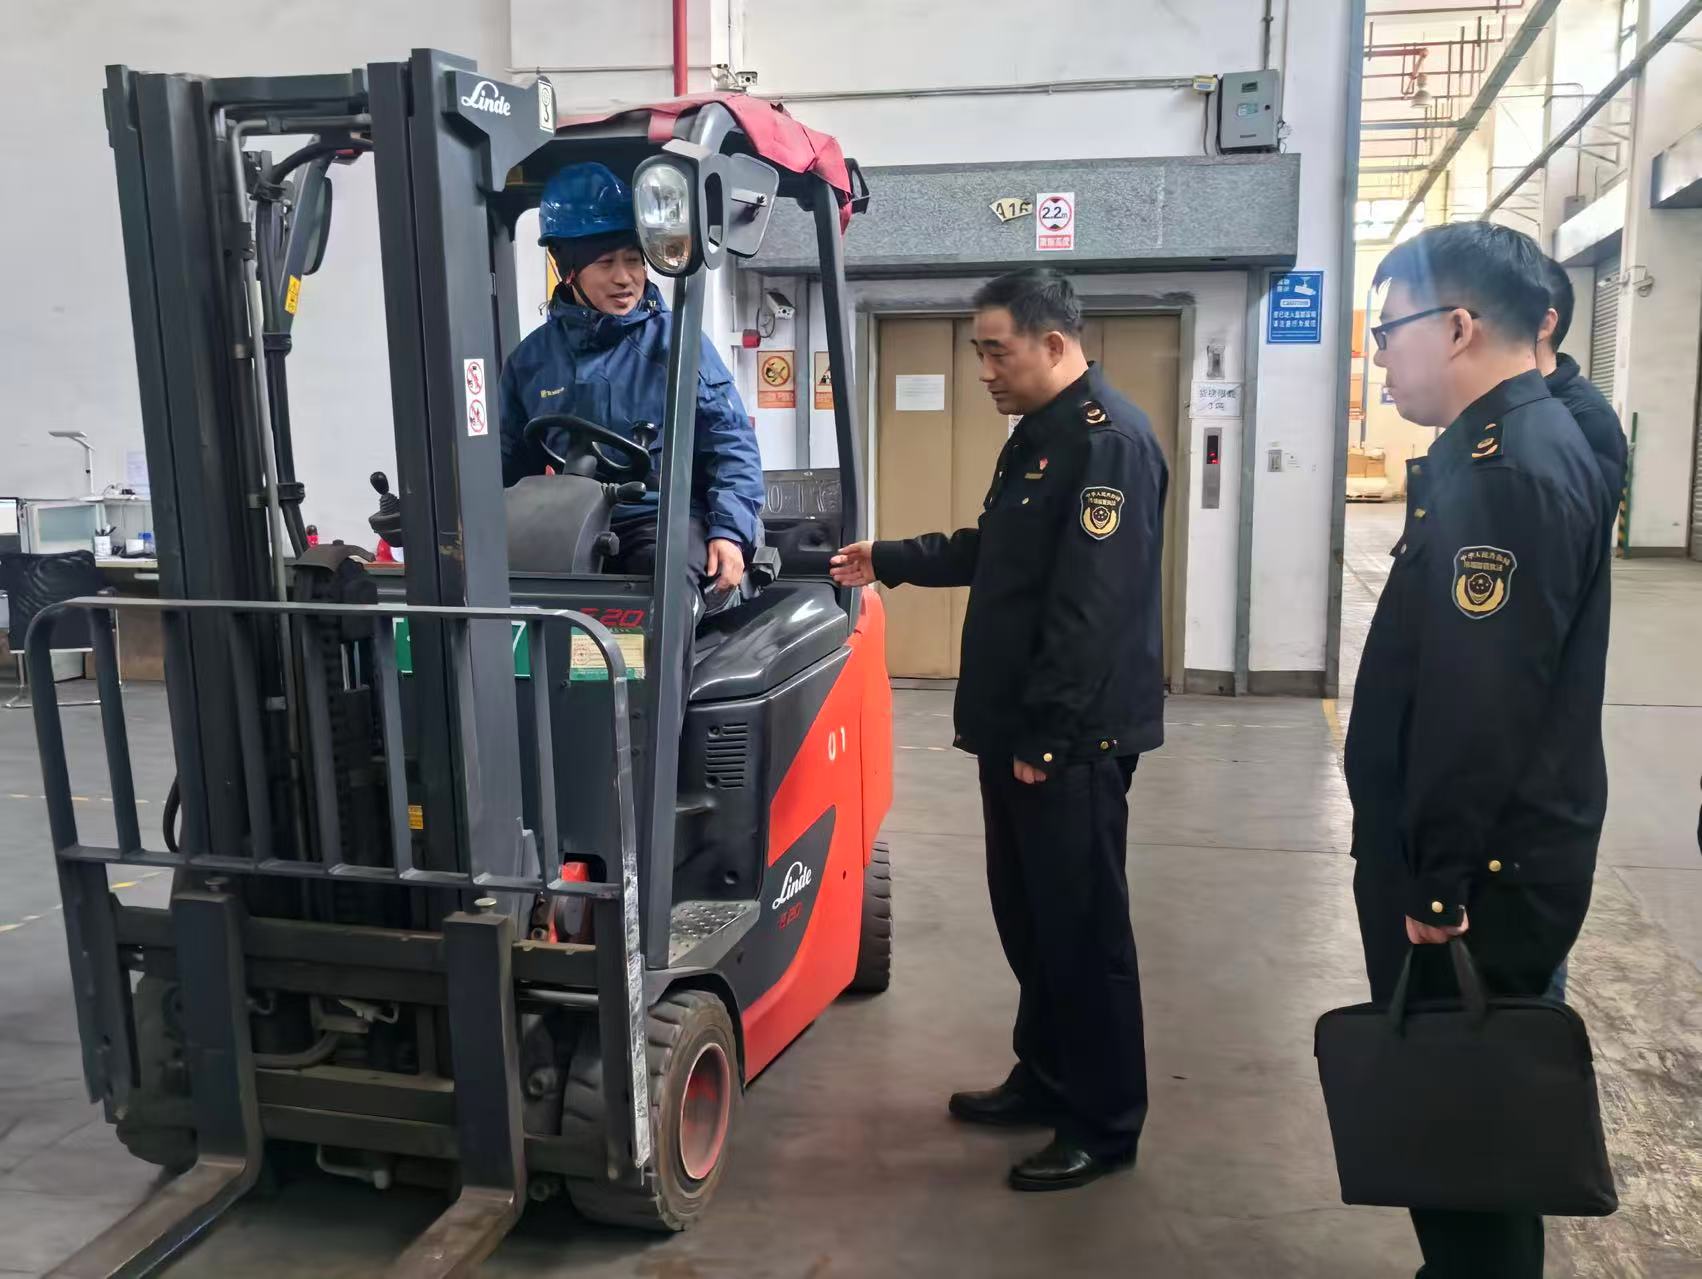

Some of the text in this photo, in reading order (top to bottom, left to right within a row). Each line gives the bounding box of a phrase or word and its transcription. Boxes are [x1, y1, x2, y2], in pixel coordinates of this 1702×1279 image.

[461, 81, 511, 116] Linde
[828, 727, 846, 761] 01
[772, 861, 812, 910] Linde
